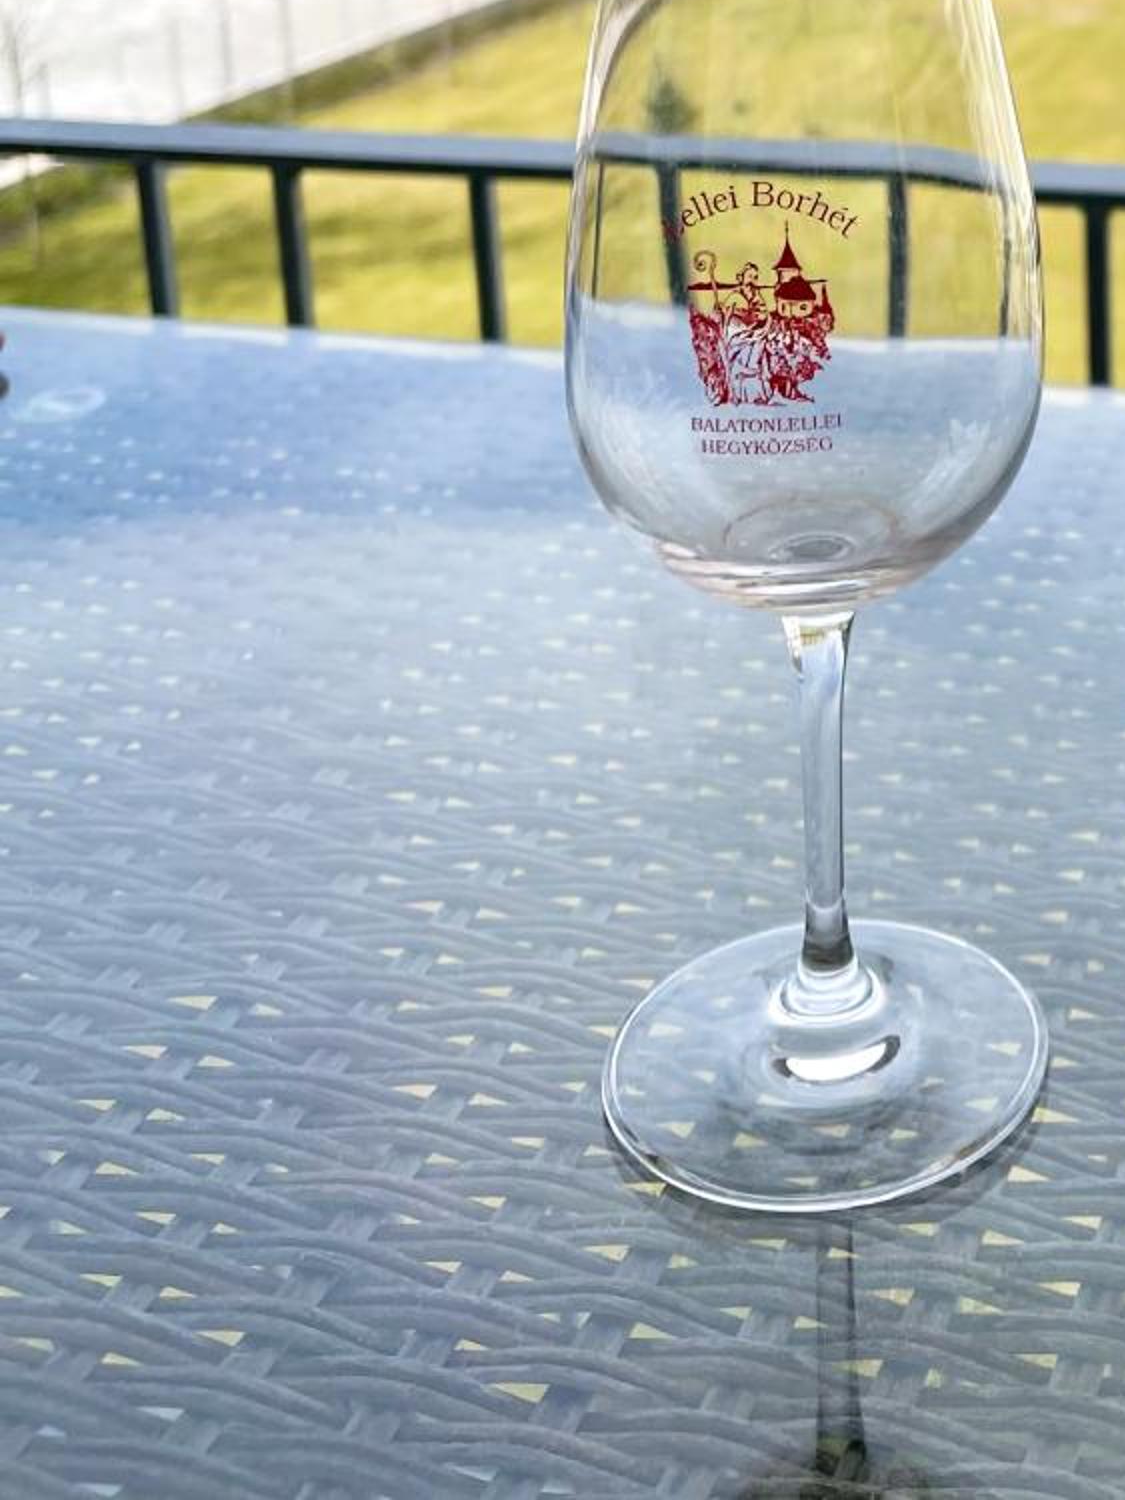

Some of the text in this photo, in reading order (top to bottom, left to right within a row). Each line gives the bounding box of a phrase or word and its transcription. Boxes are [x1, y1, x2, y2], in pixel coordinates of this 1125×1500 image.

[751, 181, 860, 238] Borhét
[691, 413, 843, 433] BALATONLELLEI
[701, 434, 833, 455] HEGYKÖZSÉG
